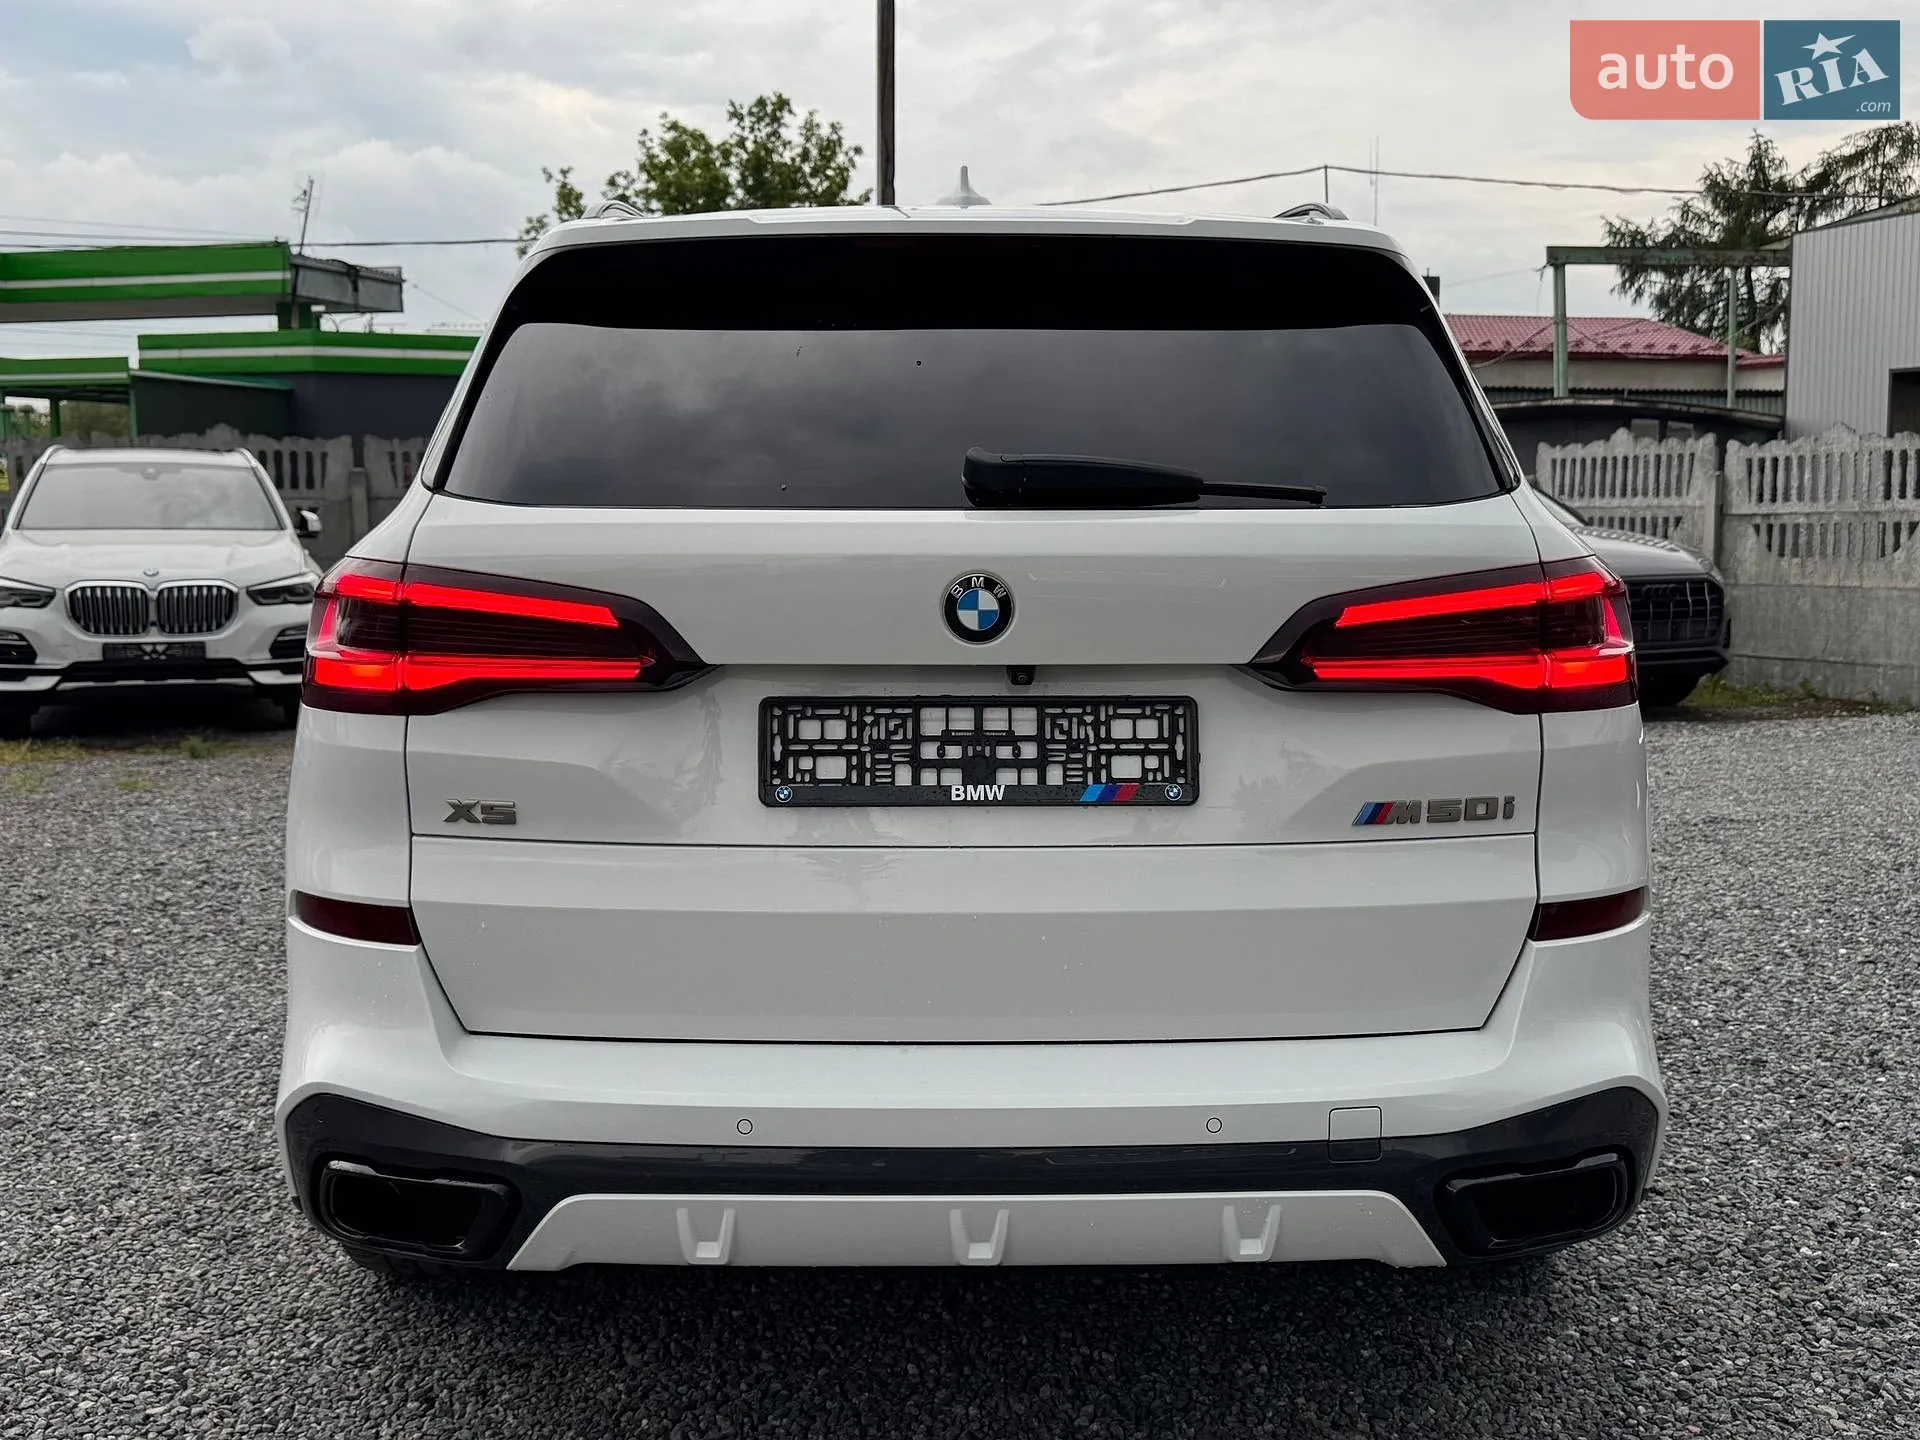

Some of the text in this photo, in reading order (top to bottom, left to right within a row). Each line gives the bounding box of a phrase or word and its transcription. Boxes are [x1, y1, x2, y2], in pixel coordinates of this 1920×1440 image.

[950, 576, 1007, 600] BMW
[951, 784, 1006, 801] BMW
[443, 798, 517, 825] X5
